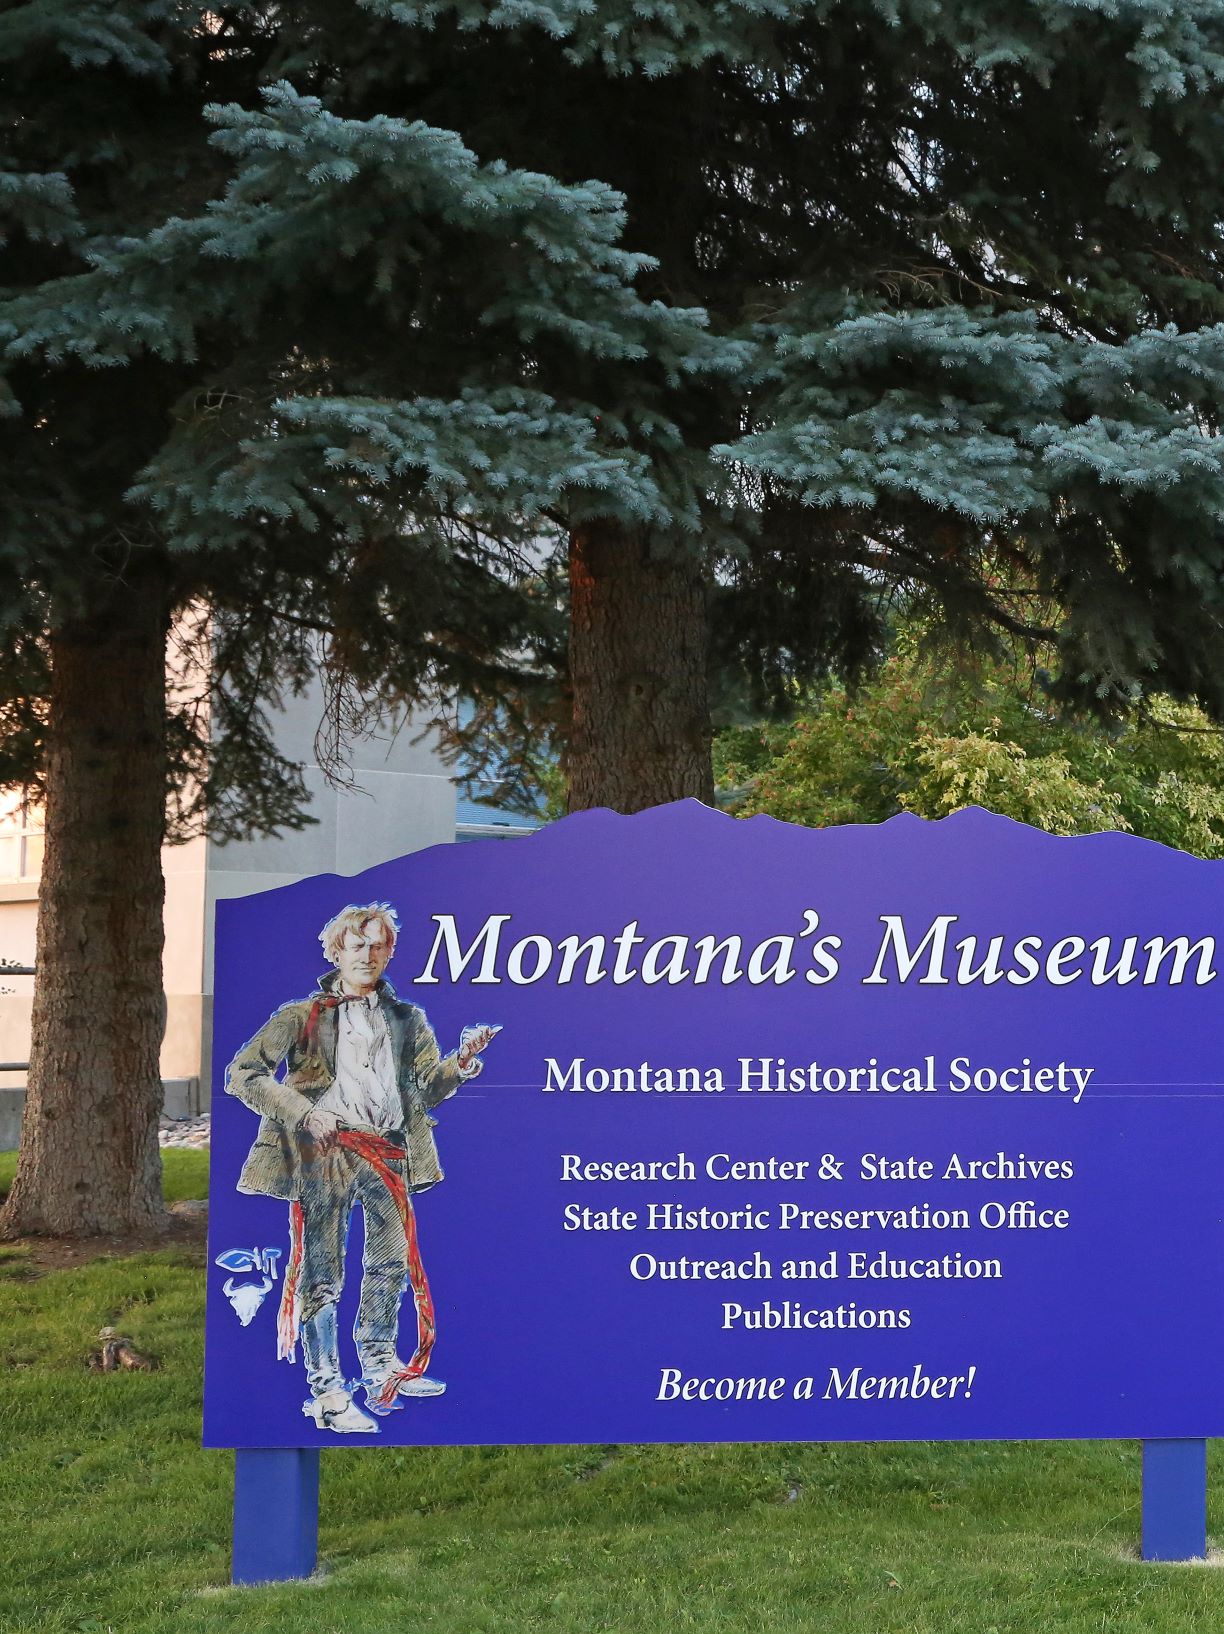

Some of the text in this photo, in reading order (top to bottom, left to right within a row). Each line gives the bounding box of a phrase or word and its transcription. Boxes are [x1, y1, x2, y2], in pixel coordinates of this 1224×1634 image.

[414, 909, 1218, 986] Montana's Museum
[541, 1055, 1094, 1104] Montana Historical Society
[560, 1151, 1074, 1180] Research Center & State Archives
[563, 1200, 1070, 1230] State Historic Preservation Office
[629, 1250, 1003, 1280] Outreach and Education
[721, 1300, 911, 1330] Publications
[656, 1363, 977, 1401] Become a Member!
